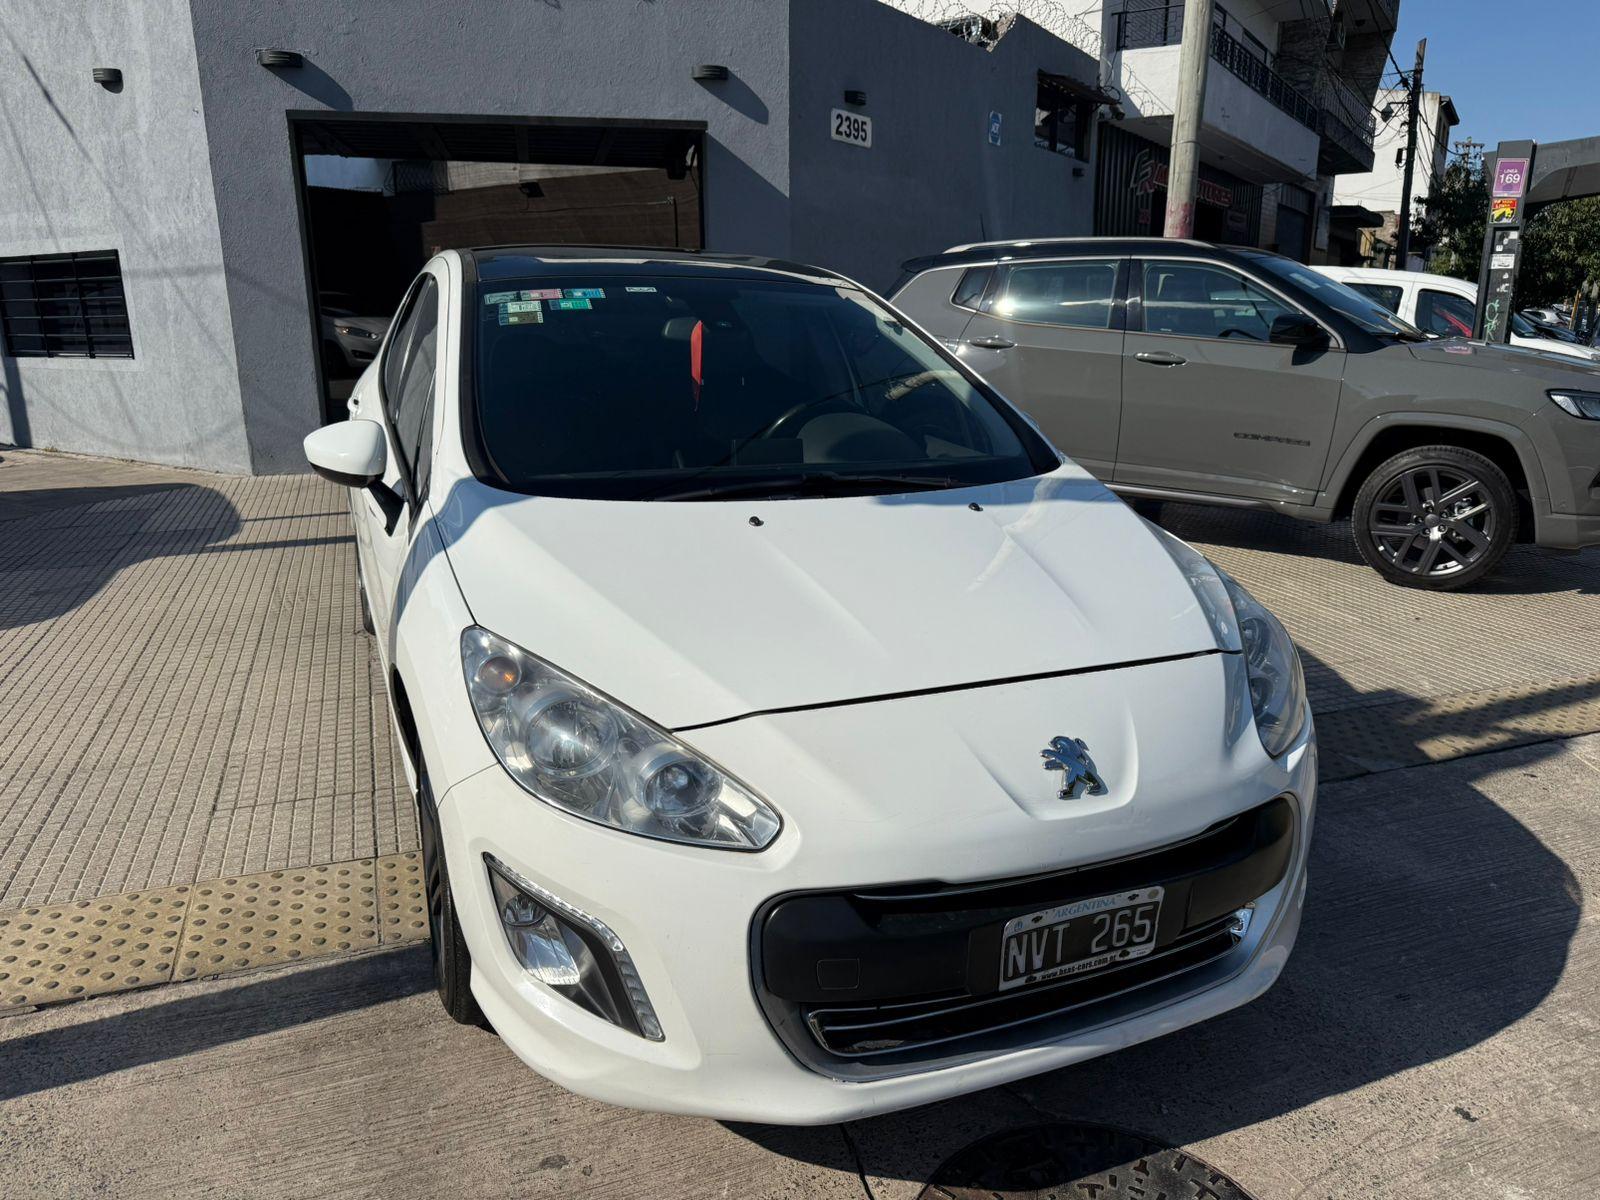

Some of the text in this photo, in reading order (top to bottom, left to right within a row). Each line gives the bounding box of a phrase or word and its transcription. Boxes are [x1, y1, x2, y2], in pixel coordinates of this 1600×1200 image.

[835, 113, 867, 142] 2395
[1499, 173, 1520, 184] 169
[1053, 899, 1117, 919] ARGENTINA
[1007, 904, 1154, 978] NVT 265
